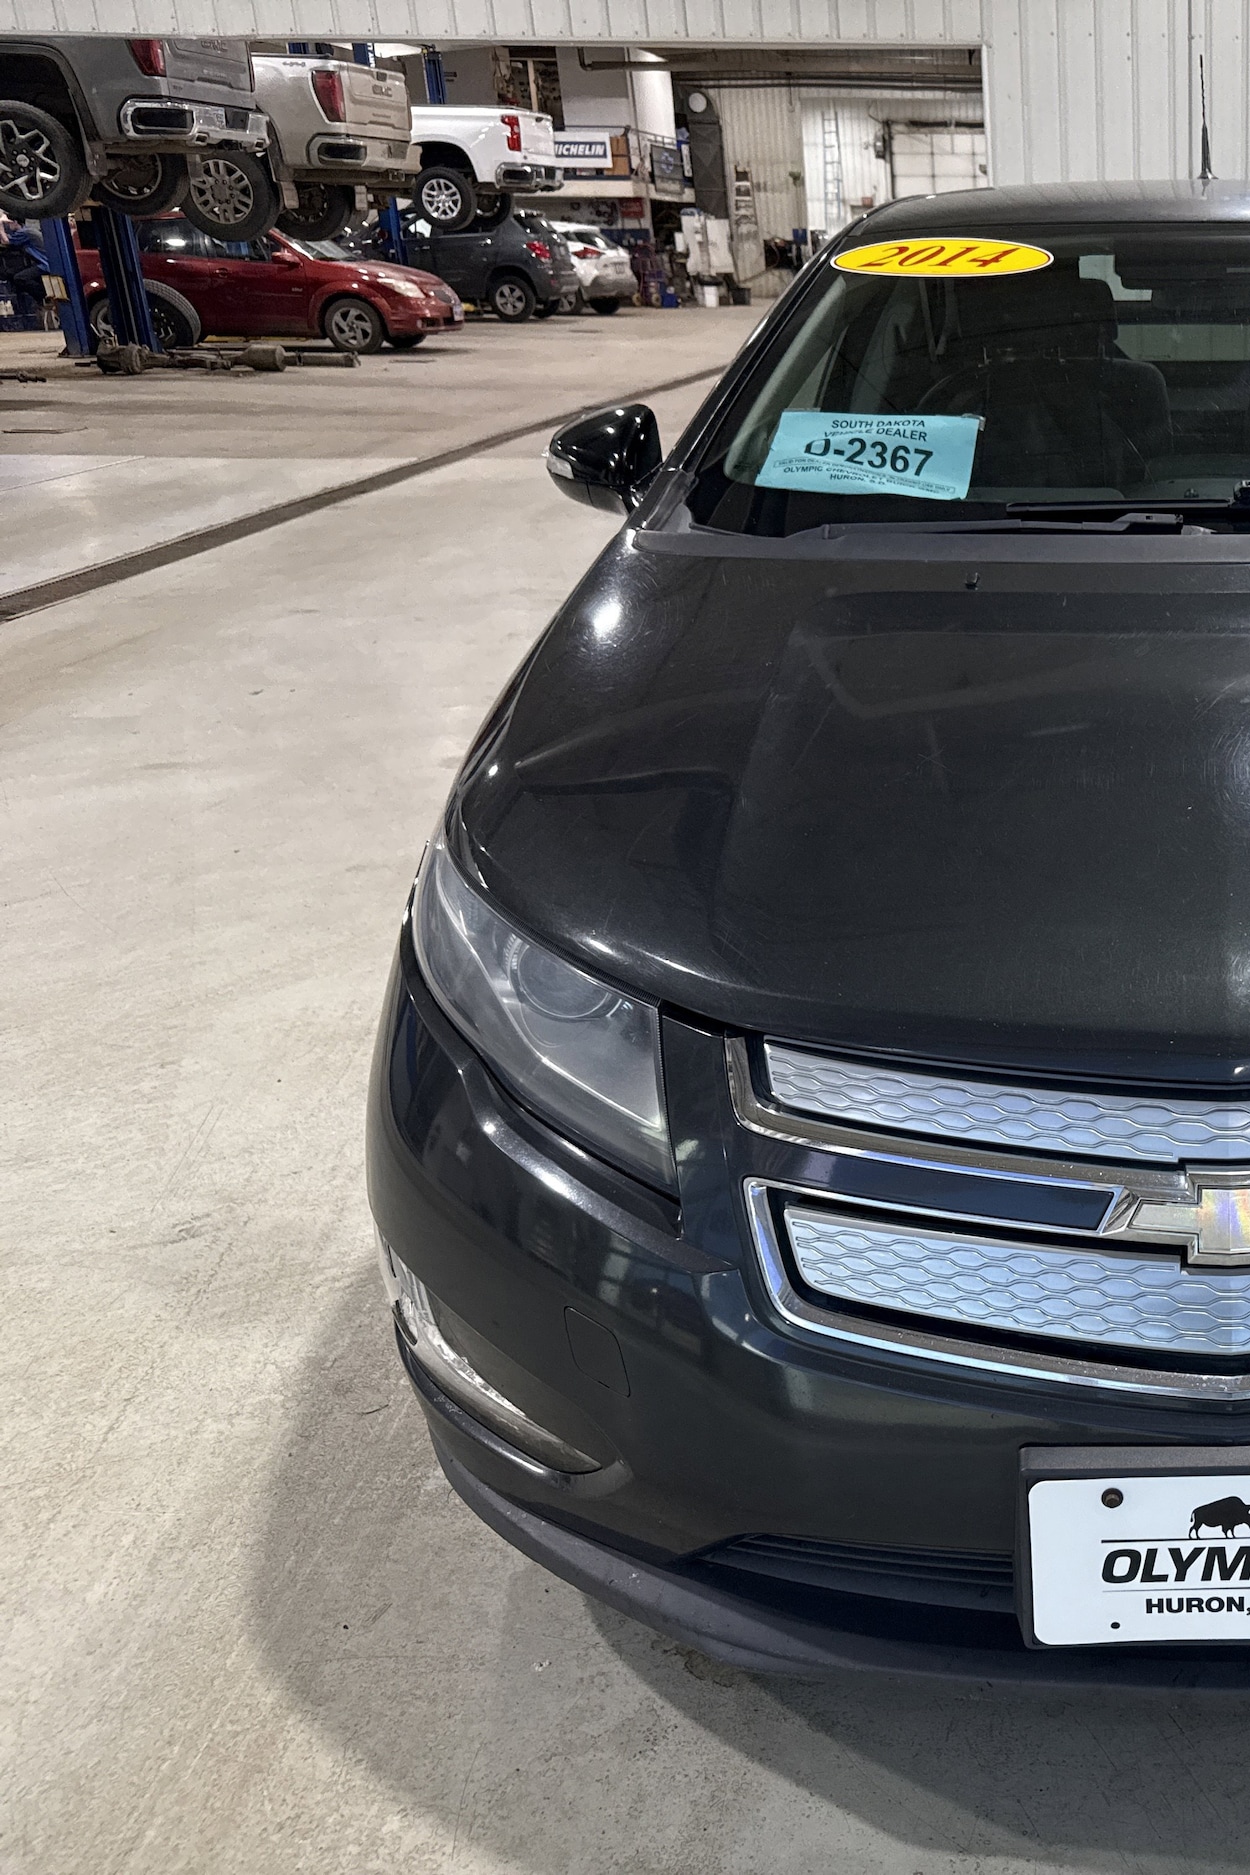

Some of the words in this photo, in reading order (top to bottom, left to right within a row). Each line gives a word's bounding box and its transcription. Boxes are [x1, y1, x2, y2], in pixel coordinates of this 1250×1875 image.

[857, 246, 1020, 268] 2014
[831, 420, 873, 429] SOUTH
[876, 419, 925, 428] DAKOTA
[876, 427, 928, 442] DEALER
[804, 437, 933, 477] D-2367
[783, 465, 824, 473] OLYMPIC
